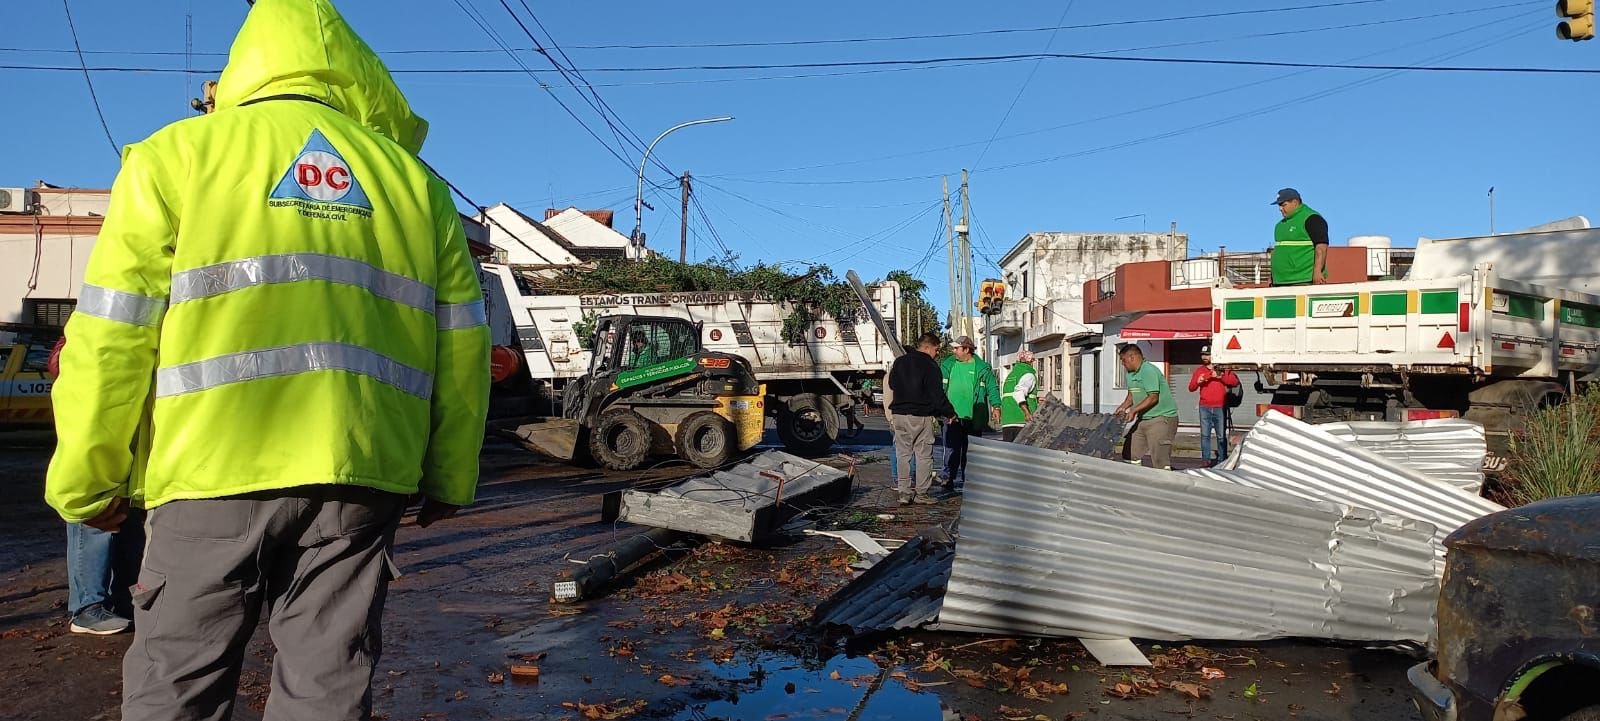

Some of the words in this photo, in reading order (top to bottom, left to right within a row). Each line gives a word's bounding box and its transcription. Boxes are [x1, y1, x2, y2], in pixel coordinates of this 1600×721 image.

[297, 163, 350, 191] DC
[302, 210, 330, 219] DEFENSA
[331, 213, 348, 221] CIVIL
[331, 205, 372, 218] EMERGENCIAS
[580, 295, 630, 306] ESTAMOS
[631, 293, 727, 305] TRANSFORMANDO
[30, 383, 52, 394] 103
